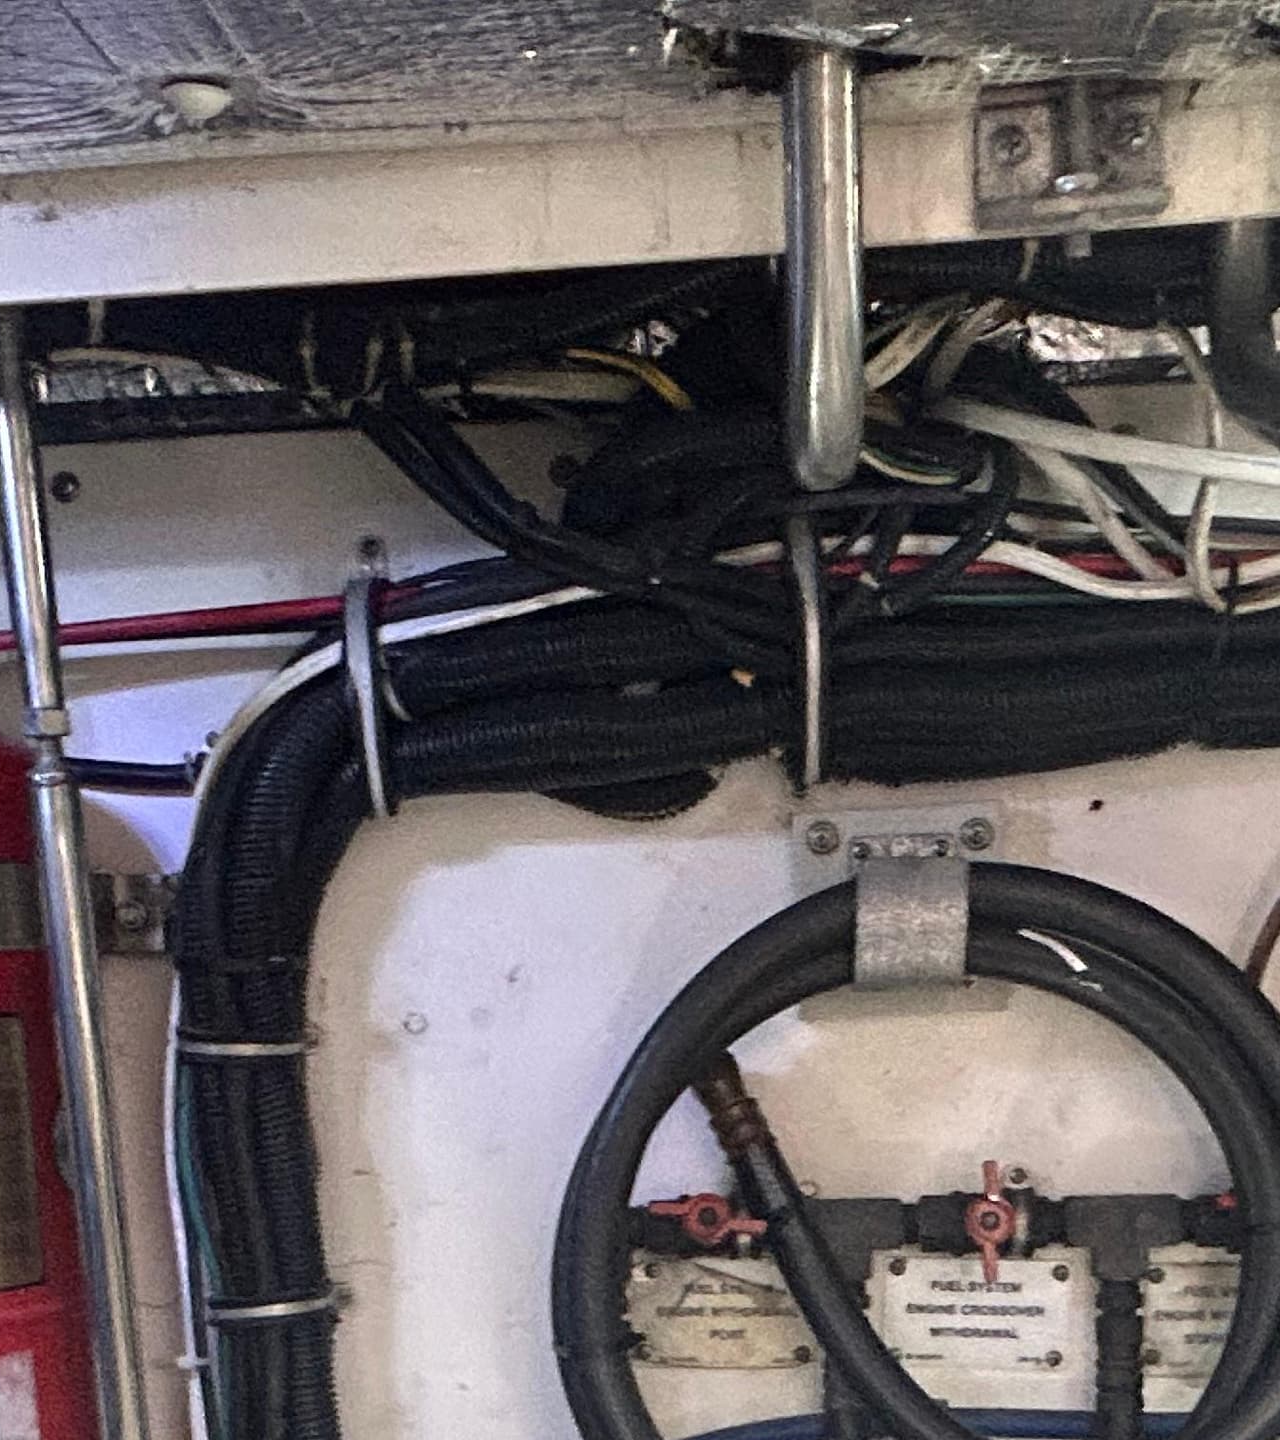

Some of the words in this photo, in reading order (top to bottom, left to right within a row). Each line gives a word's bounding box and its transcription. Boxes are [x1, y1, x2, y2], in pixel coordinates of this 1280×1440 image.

[931, 1280, 965, 1293] FUEL
[968, 1280, 1022, 1294] SYSTEM
[905, 1302, 957, 1315] ENGINE
[960, 1303, 1045, 1317] CROSSOVER
